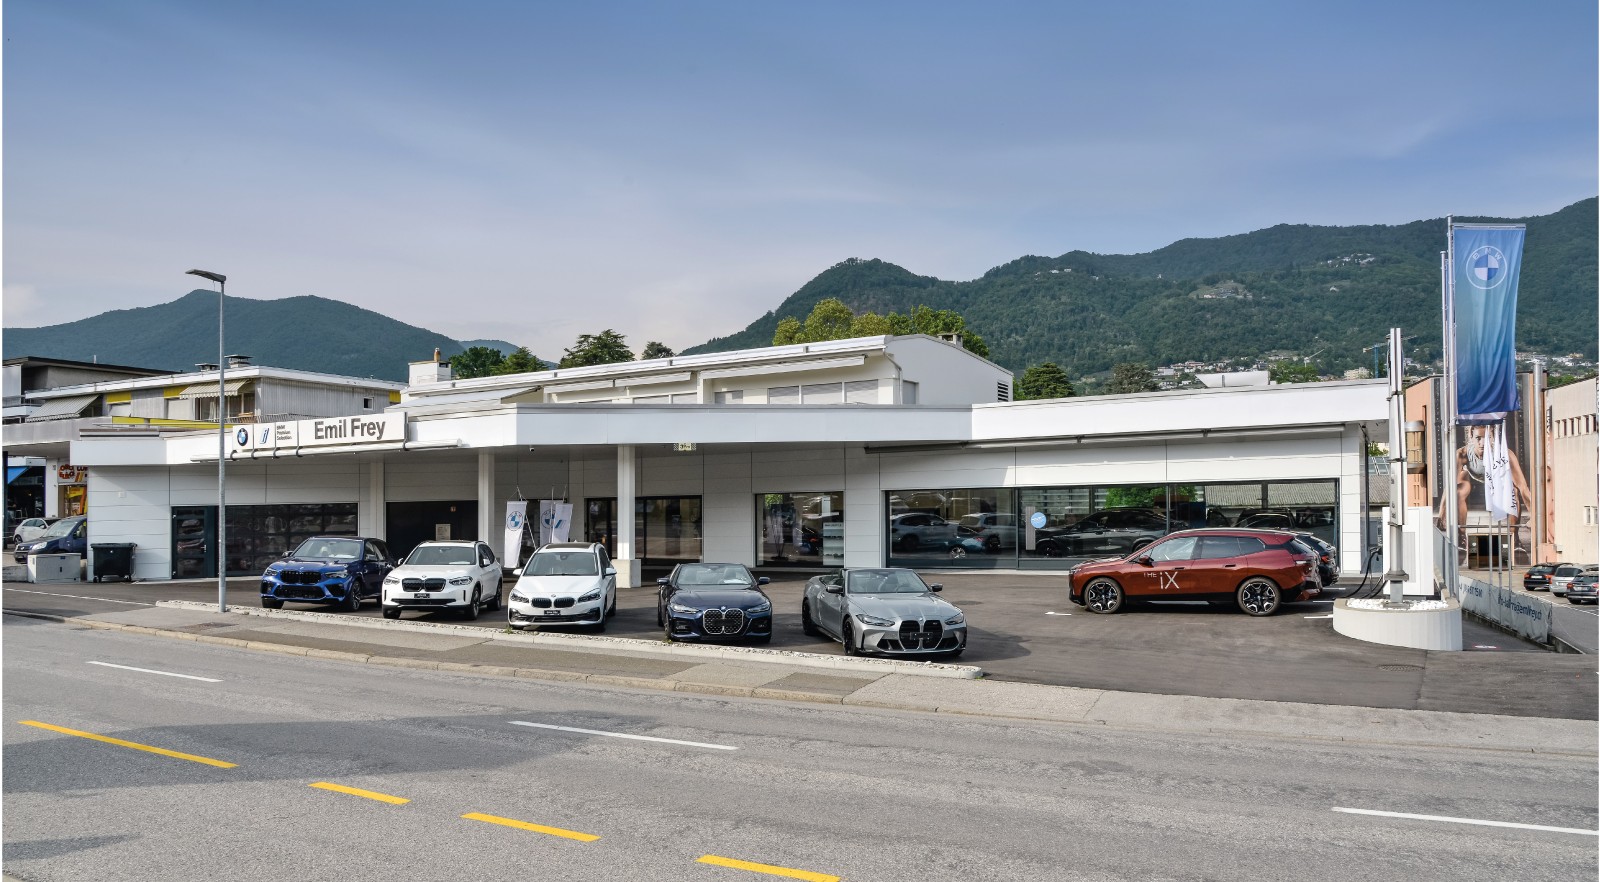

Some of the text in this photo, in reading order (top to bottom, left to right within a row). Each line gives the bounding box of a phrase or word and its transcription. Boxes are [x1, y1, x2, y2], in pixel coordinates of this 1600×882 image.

[314, 417, 386, 440] Emil Frey
[1159, 571, 1180, 590] iX
